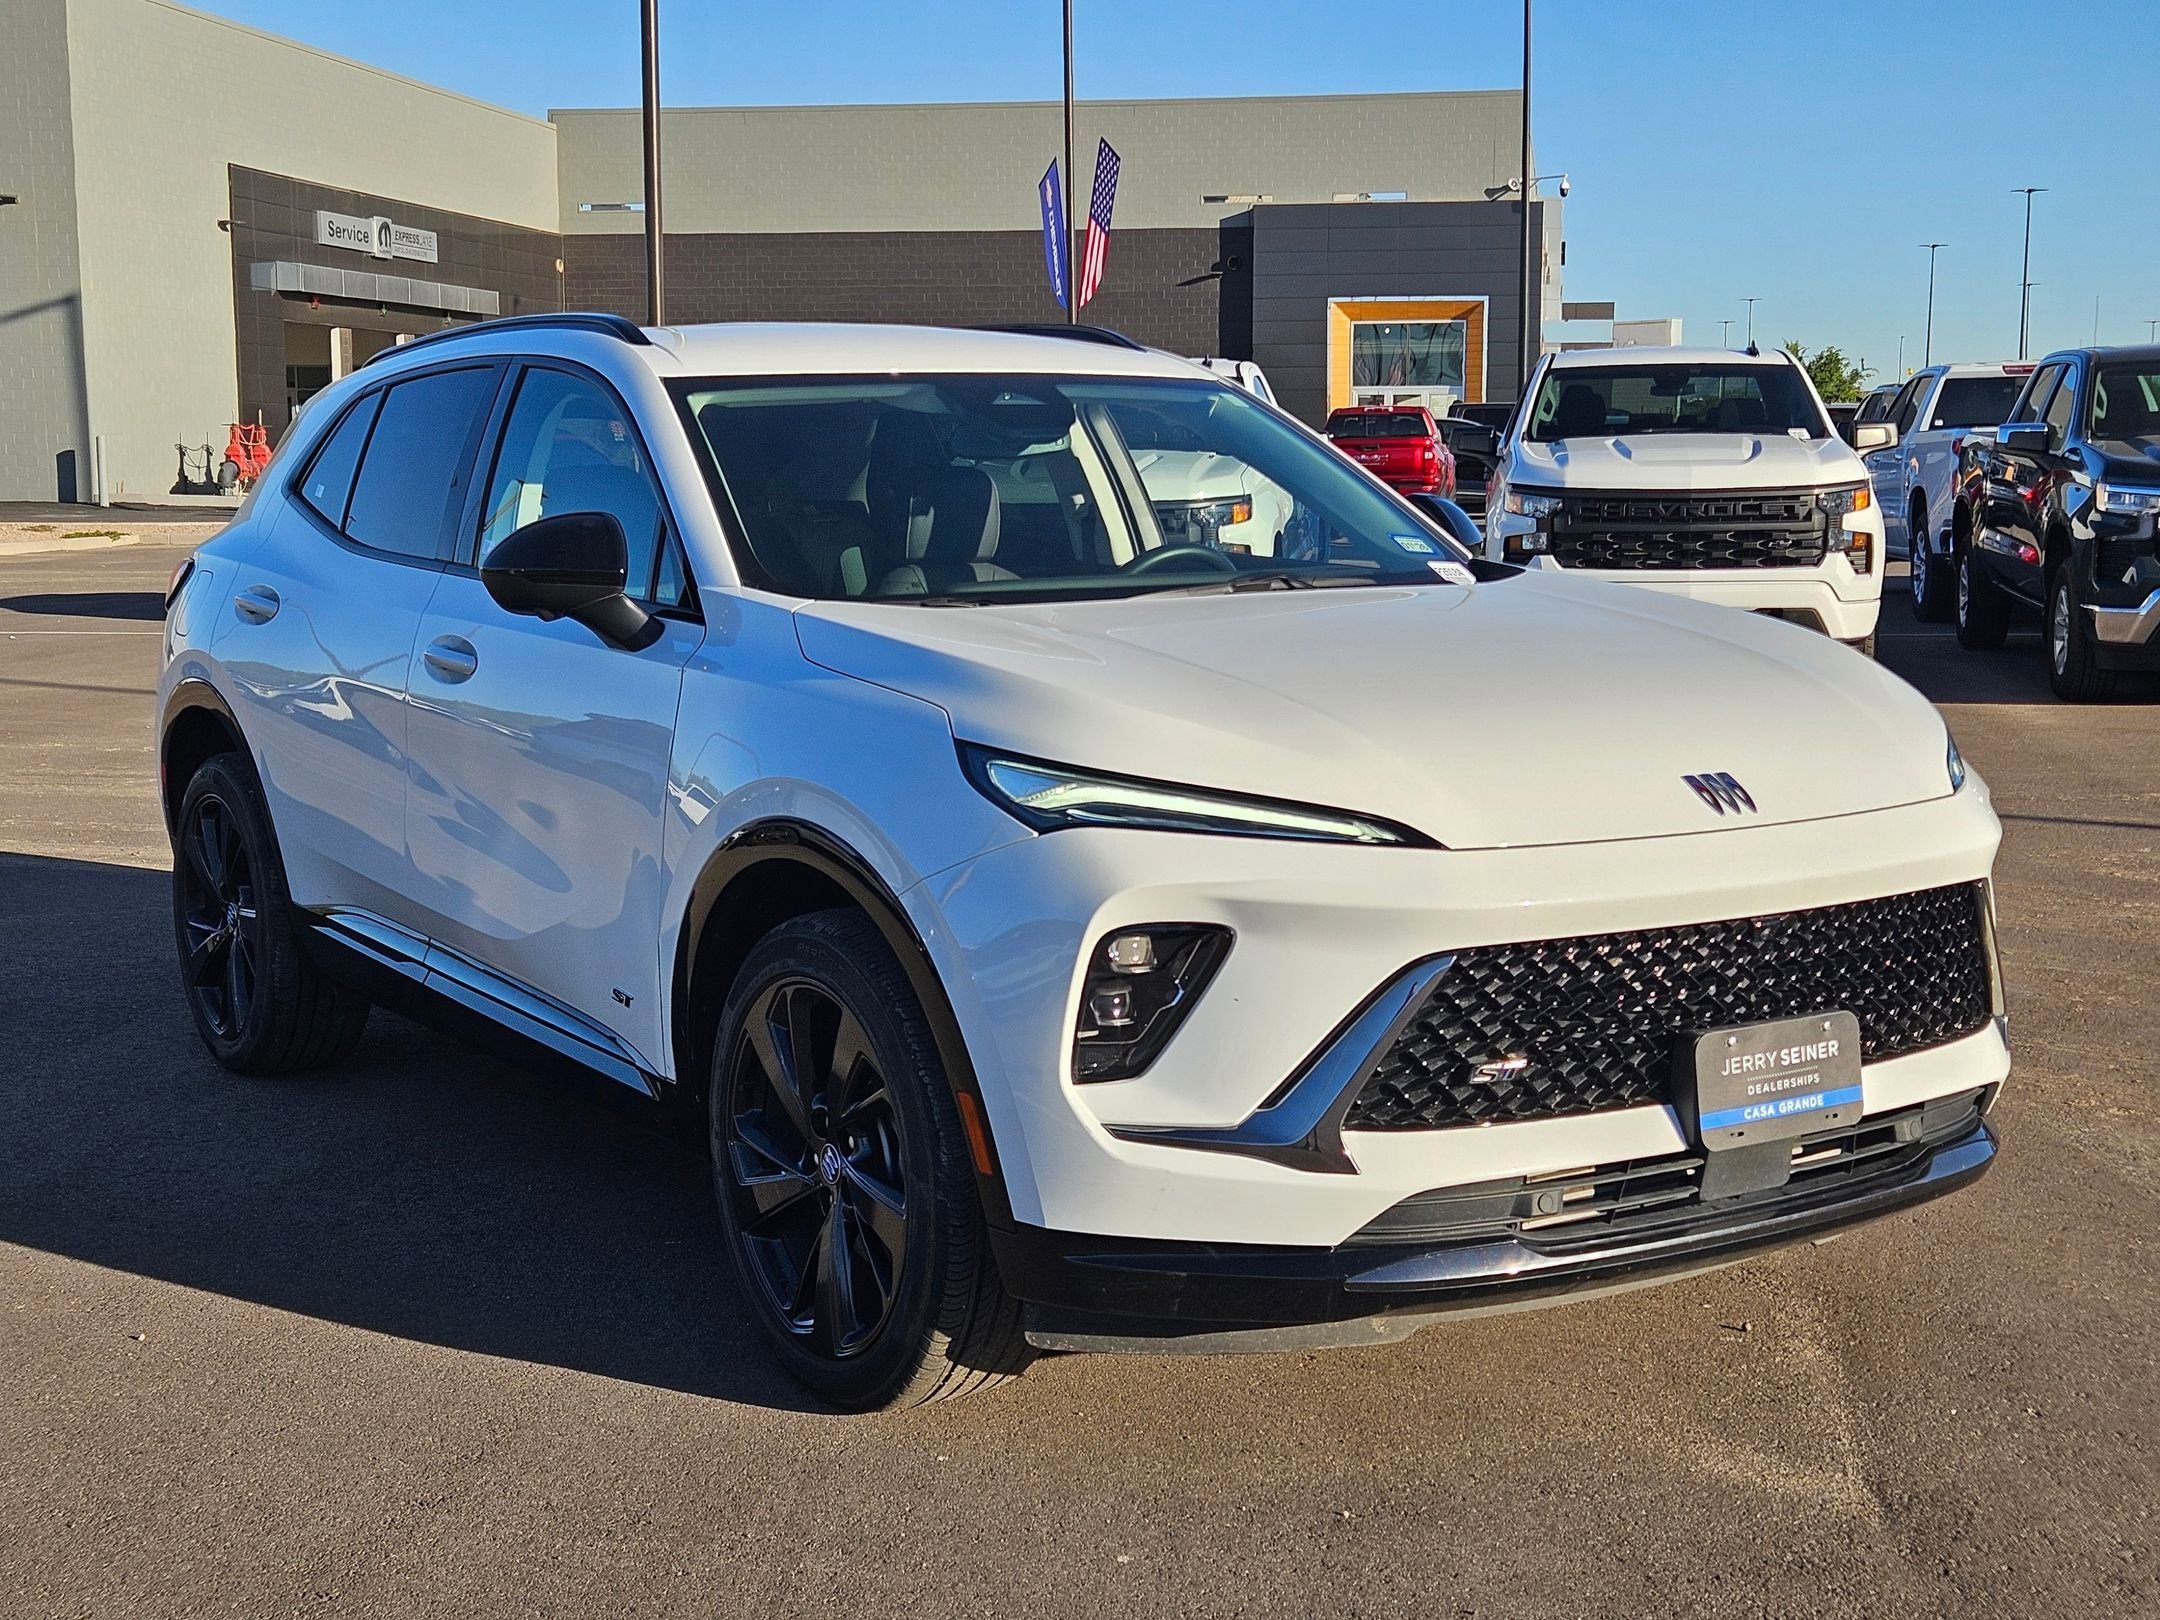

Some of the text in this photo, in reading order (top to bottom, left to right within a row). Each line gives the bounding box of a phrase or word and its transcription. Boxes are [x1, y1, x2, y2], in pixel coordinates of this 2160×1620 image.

[328, 220, 370, 244] Service
[1048, 210, 1063, 297] CHEVROLET
[1577, 501, 1811, 519] CHEVROLET
[611, 986, 634, 1009] ST
[1721, 1039, 1840, 1076] JERRY SEINER
[1469, 1058, 1528, 1085] ST
[1747, 1073, 1821, 1096] DEALERSHIPS
[1744, 1095, 1825, 1120] CASA GRANDE
